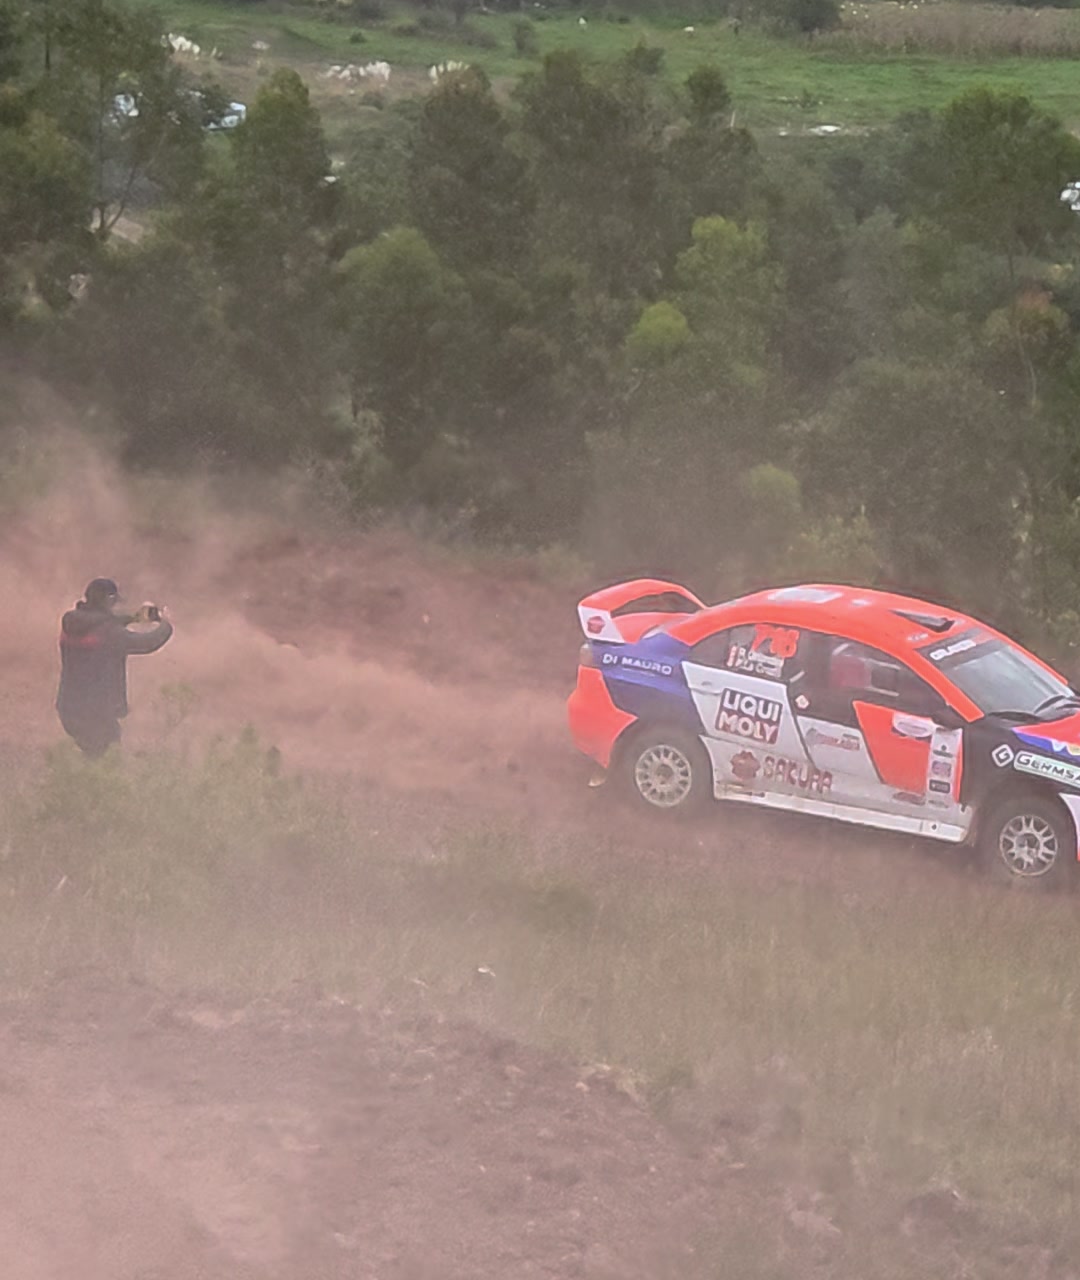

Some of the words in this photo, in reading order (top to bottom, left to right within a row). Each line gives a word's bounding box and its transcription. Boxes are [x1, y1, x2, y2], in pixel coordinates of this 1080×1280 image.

[602, 653, 618, 665] DI
[621, 657, 673, 676] MAURO
[723, 690, 780, 722] LIQUI
[718, 711, 777, 742] MOLY
